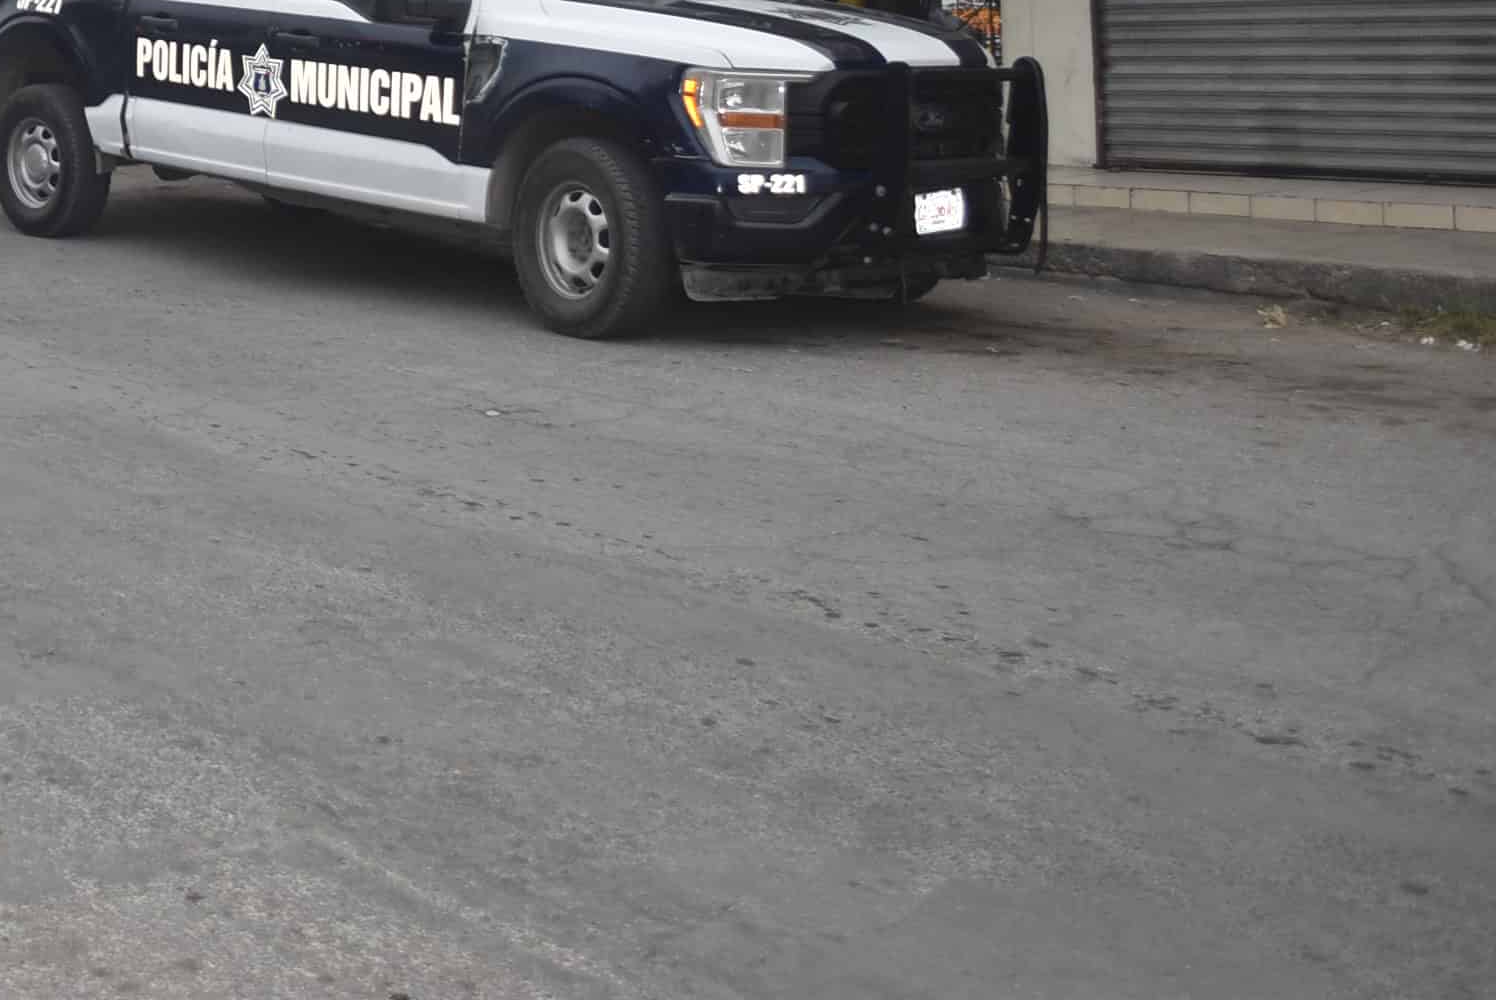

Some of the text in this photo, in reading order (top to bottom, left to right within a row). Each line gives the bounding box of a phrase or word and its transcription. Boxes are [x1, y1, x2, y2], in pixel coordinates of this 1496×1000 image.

[136, 37, 460, 126] POLICÍA MUNICIPAL
[737, 173, 807, 195] SP-221
